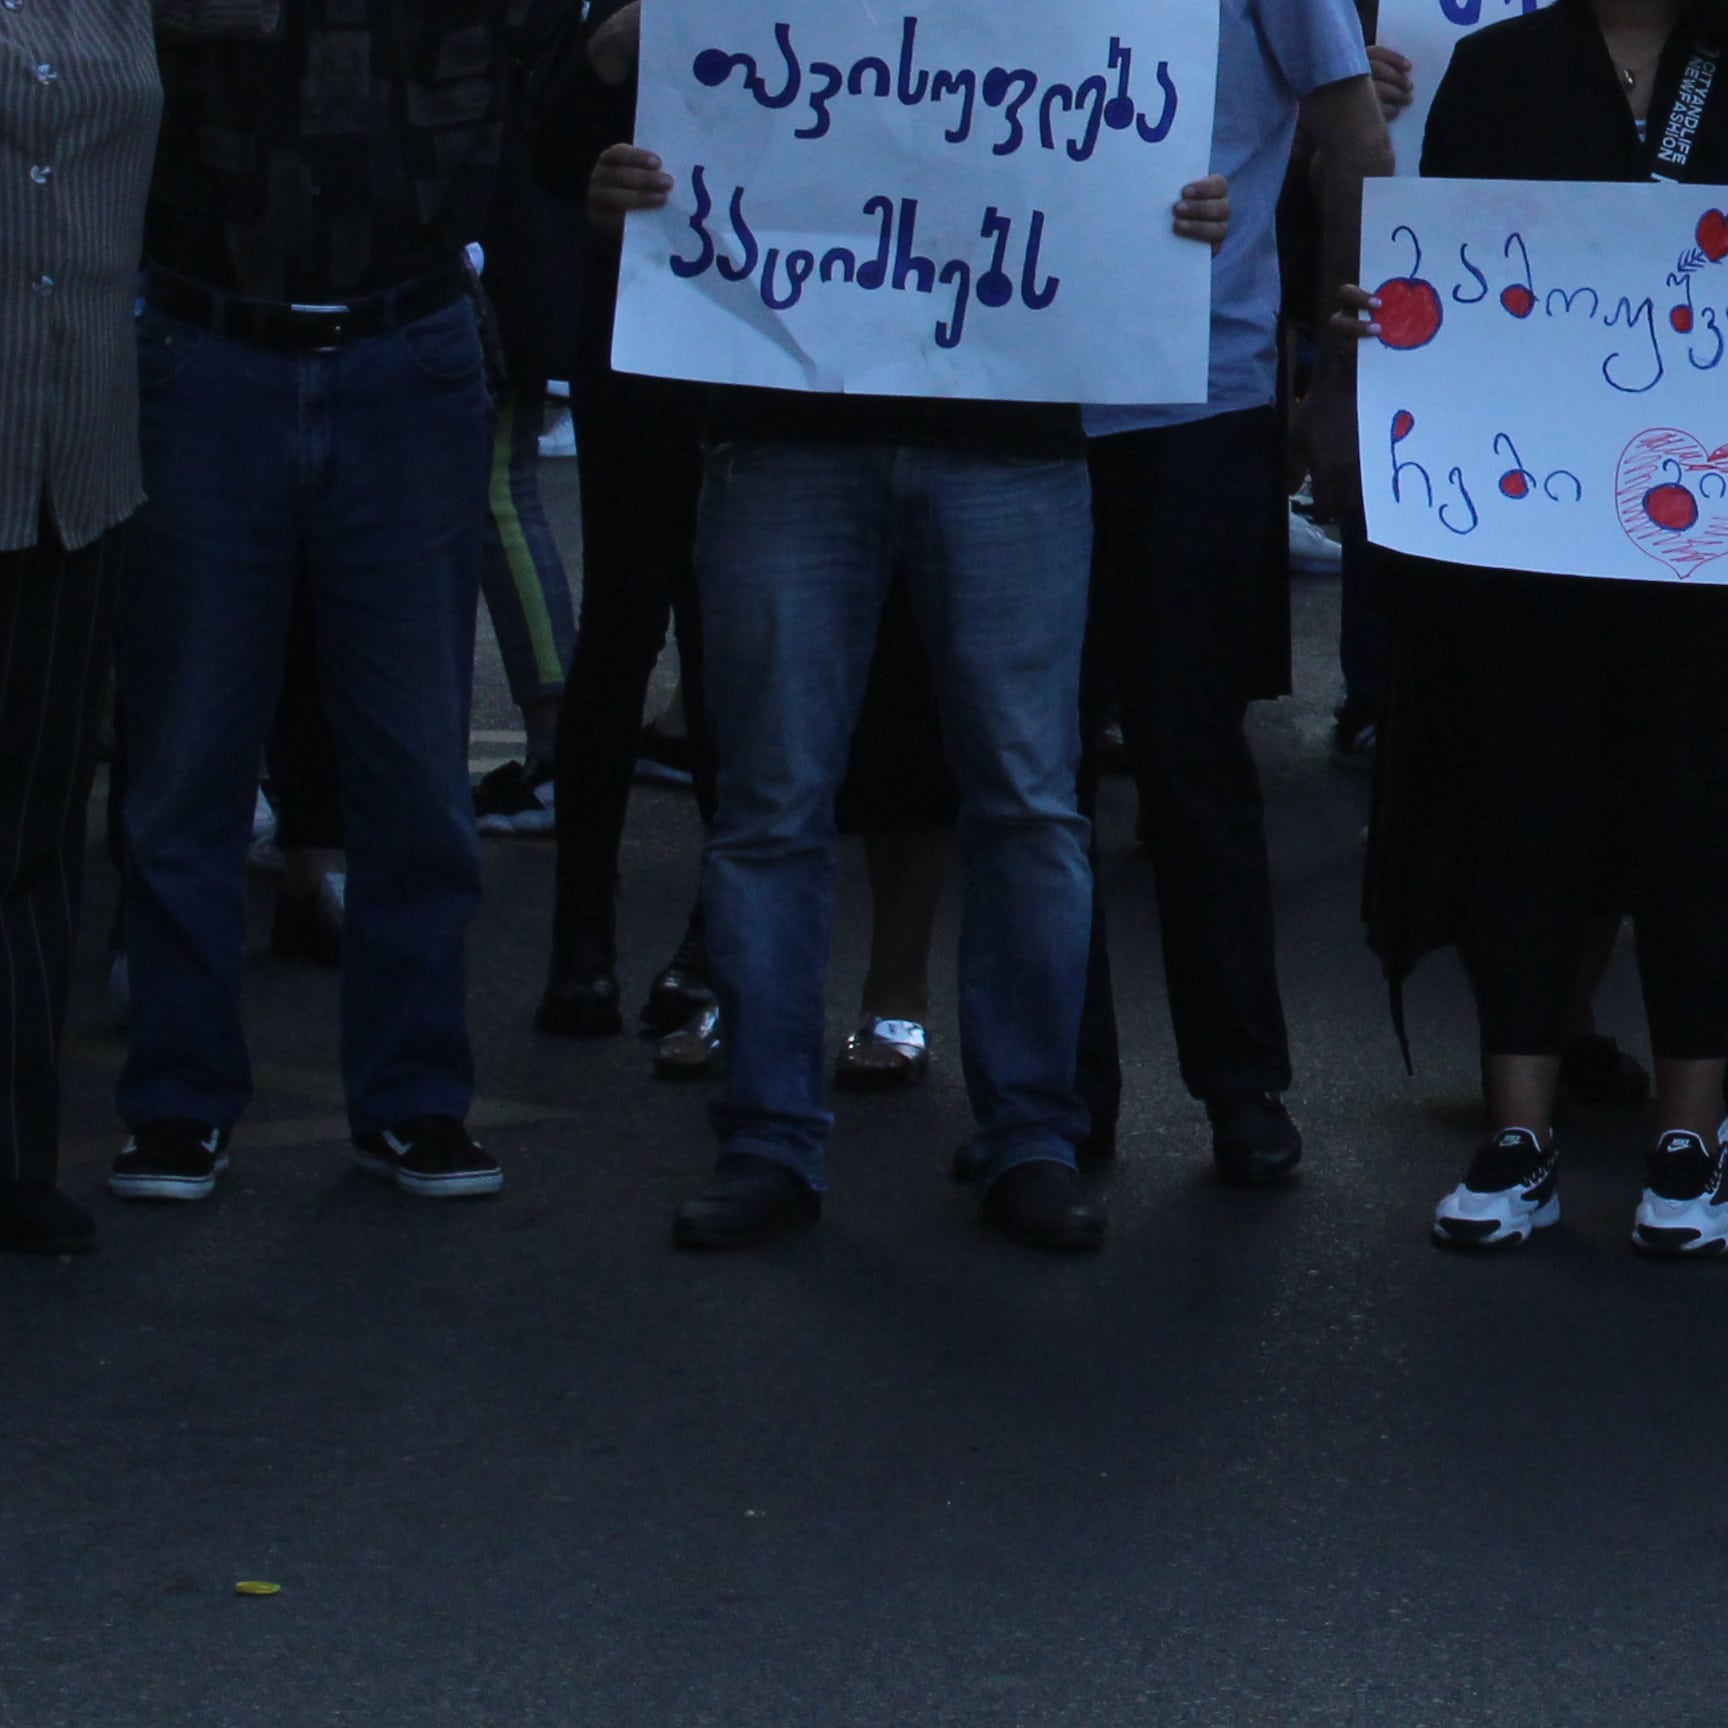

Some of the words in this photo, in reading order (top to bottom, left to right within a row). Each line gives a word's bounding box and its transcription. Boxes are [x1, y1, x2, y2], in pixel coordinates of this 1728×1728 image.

[693, 16, 1178, 161] თავისუფლება
[669, 164, 1060, 349] პატიმრებს
[1390, 409, 1583, 534] ჩემი
